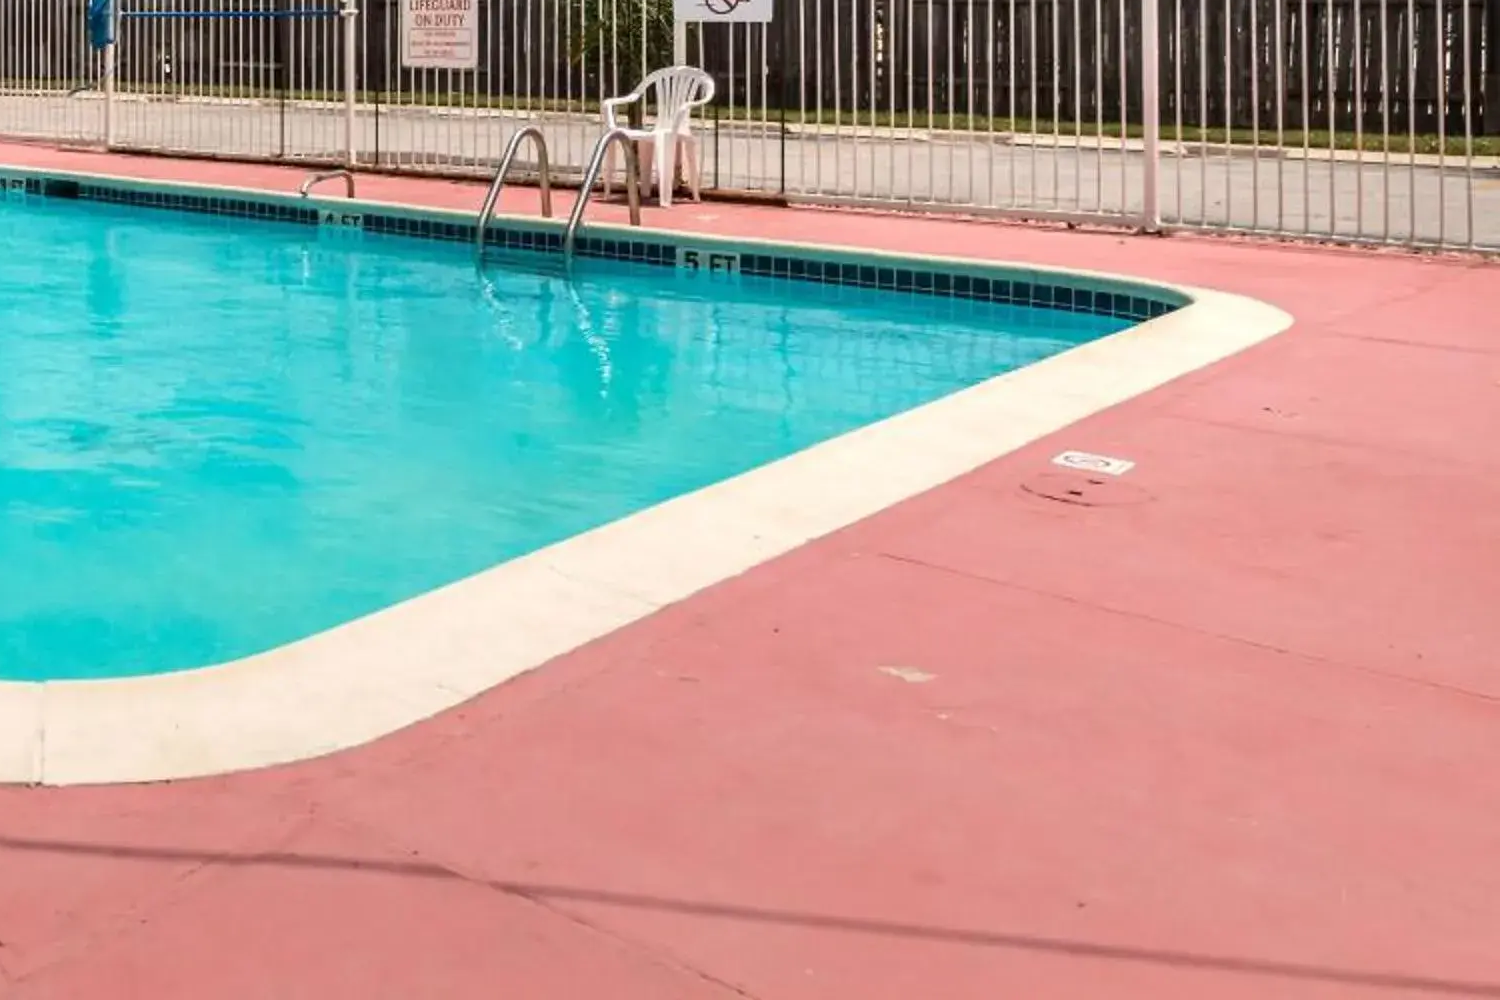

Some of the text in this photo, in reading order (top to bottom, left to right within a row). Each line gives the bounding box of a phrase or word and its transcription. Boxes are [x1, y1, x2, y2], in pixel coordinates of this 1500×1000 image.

[409, 0, 471, 11] LIFEGUARD
[415, 14, 465, 26] ON DUTY
[710, 253, 736, 272] FT
